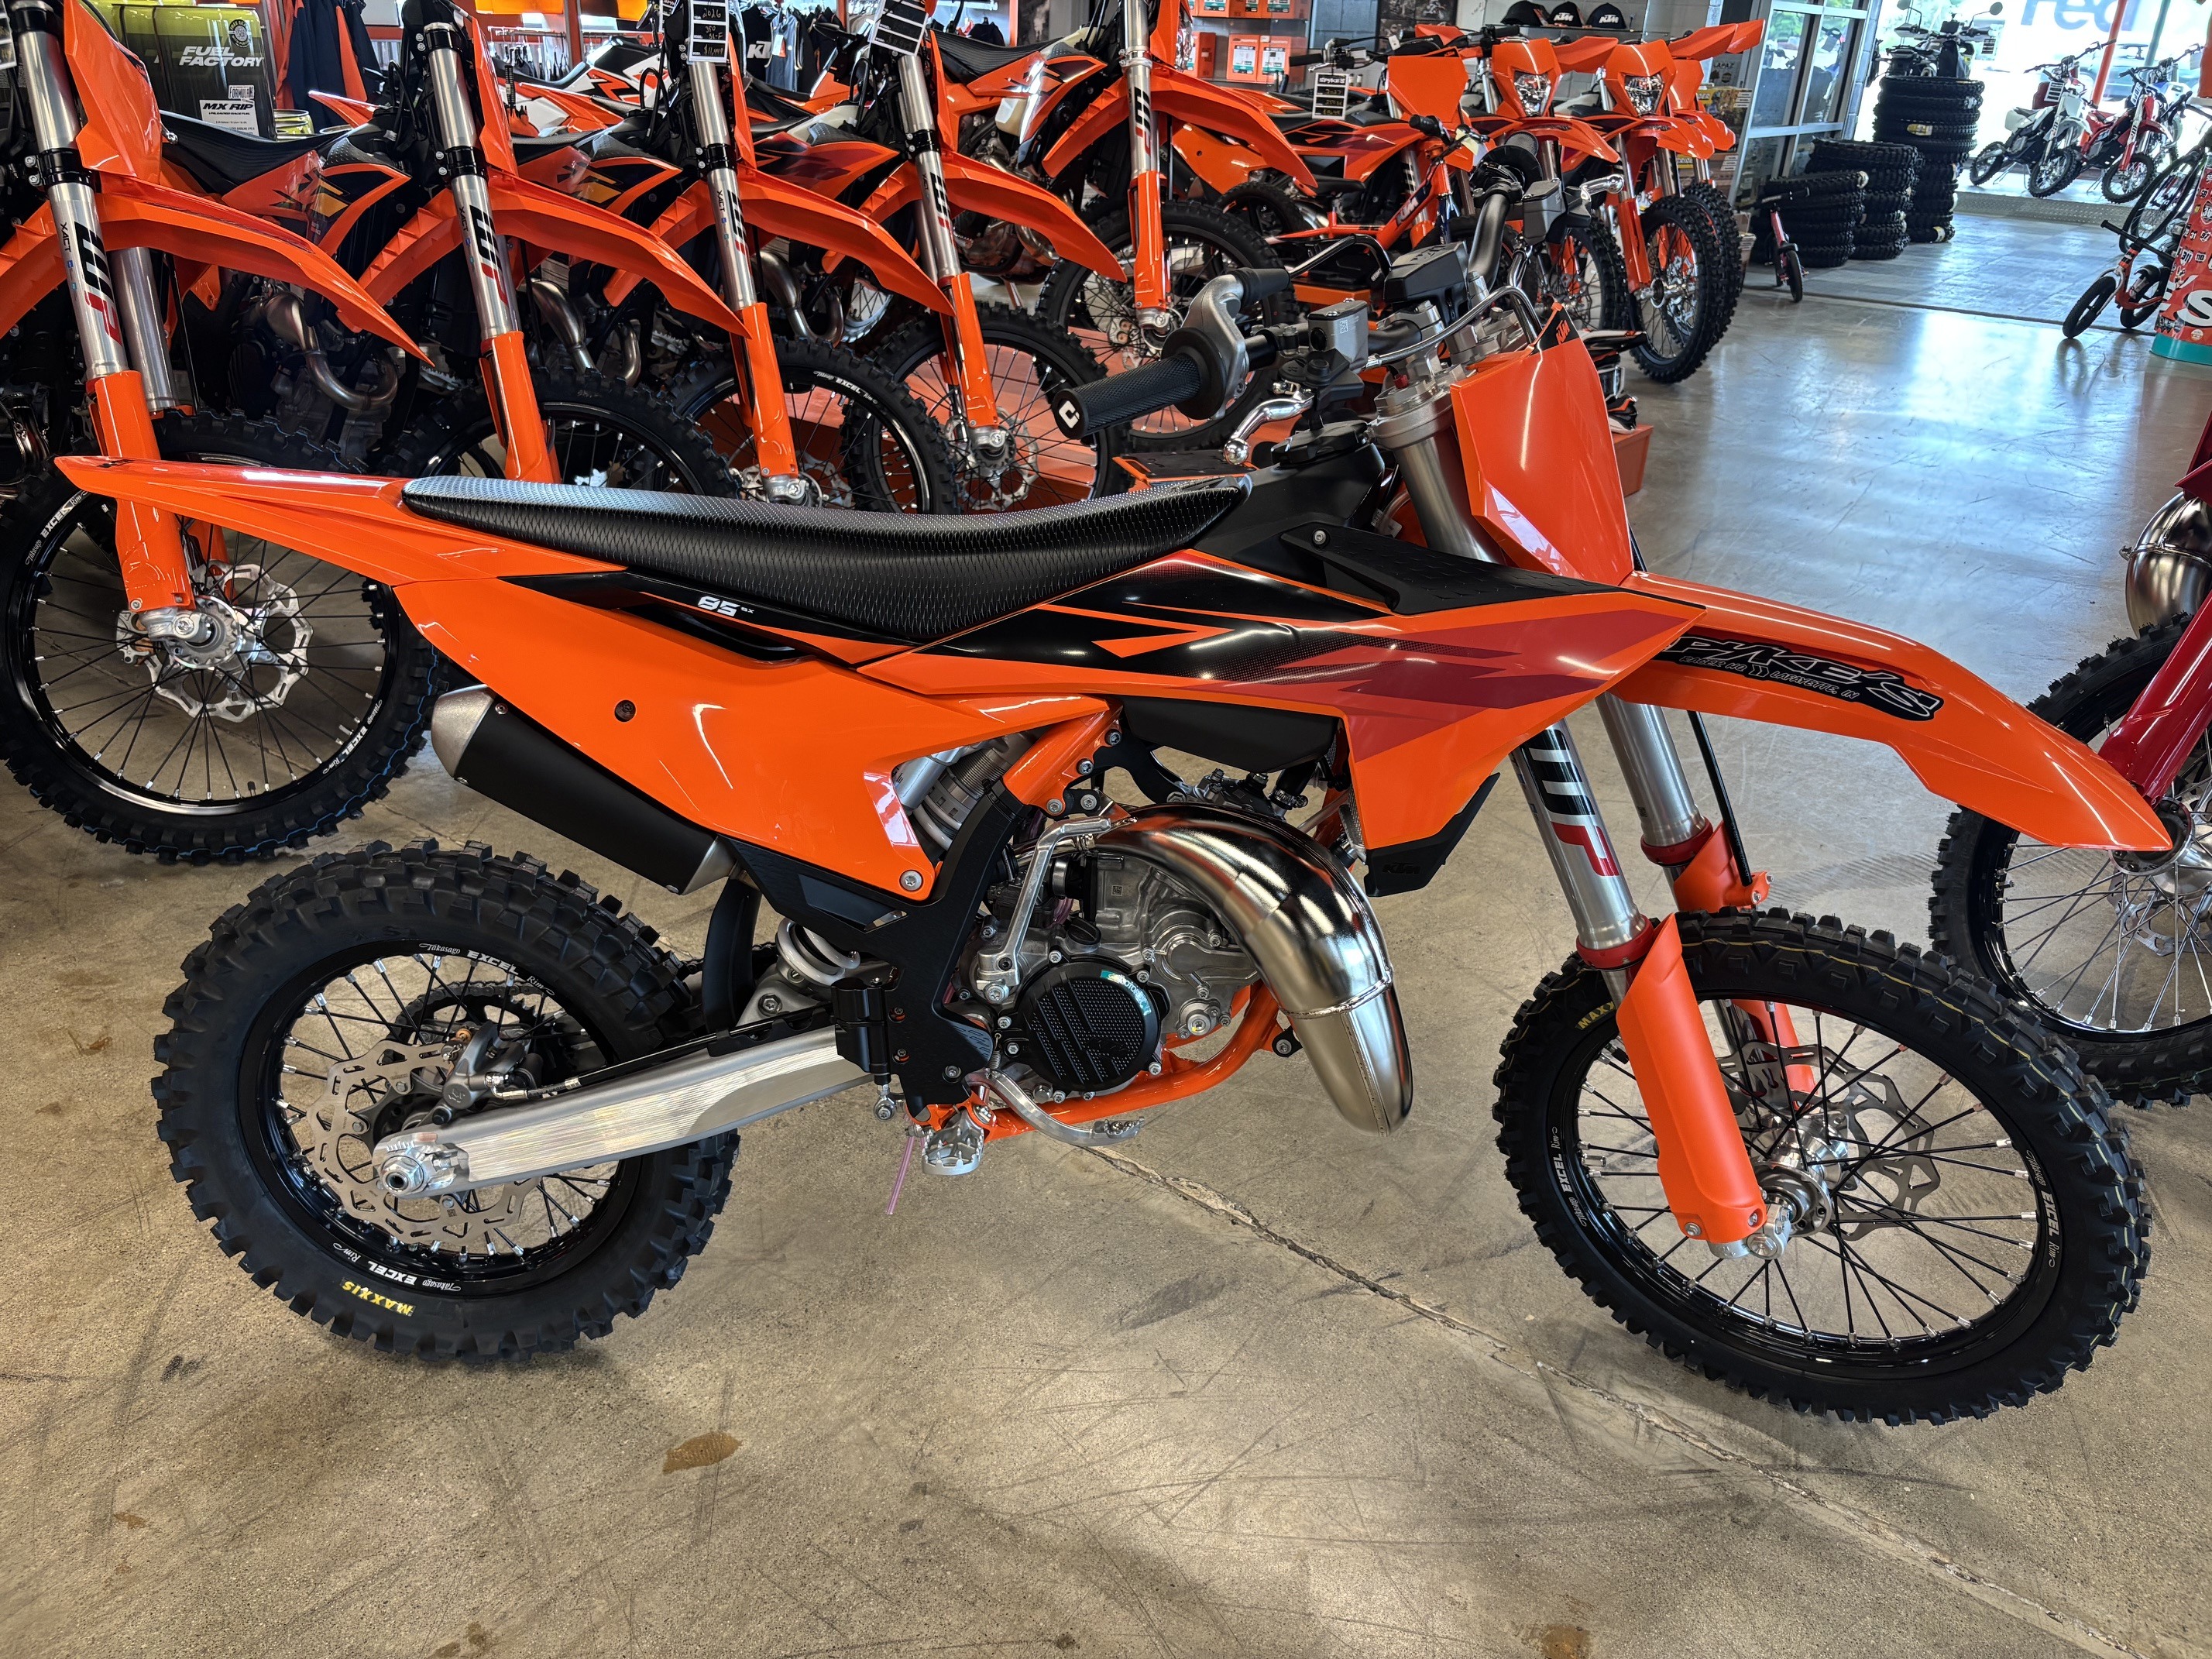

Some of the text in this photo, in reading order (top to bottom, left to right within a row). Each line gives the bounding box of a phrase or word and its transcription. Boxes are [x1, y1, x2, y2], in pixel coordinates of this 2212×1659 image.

[702, 8, 722, 19] 2026
[1554, 12, 1574, 22] KTM
[1599, 14, 1620, 24] KTM
[178, 56, 265, 67] FACTORY
[182, 46, 235, 57] FUEL
[717, 190, 726, 212] XACT
[459, 207, 469, 232] XACT
[60, 222, 72, 253] XACT
[1556, 319, 1571, 345] KTM
[836, 377, 861, 394] EXCEL
[40, 503, 74, 538] EXCEL
[697, 596, 740, 617] 85
[1662, 635, 1941, 718] PYKE'S
[1679, 654, 1860, 699] RACER HQ LAFAYETTE, IN
[342, 726, 368, 755] EXCEL
[419, 943, 555, 996] Takasago EXCEL Rim
[1553, 1153, 1573, 1193] EXCEL
[2041, 1190, 2059, 1237] EXCEL
[332, 1242, 462, 1291] Takasago EXCEL Rim
[2049, 1241, 2059, 1268] Rim
[342, 1281, 414, 1316] MAXXIS
